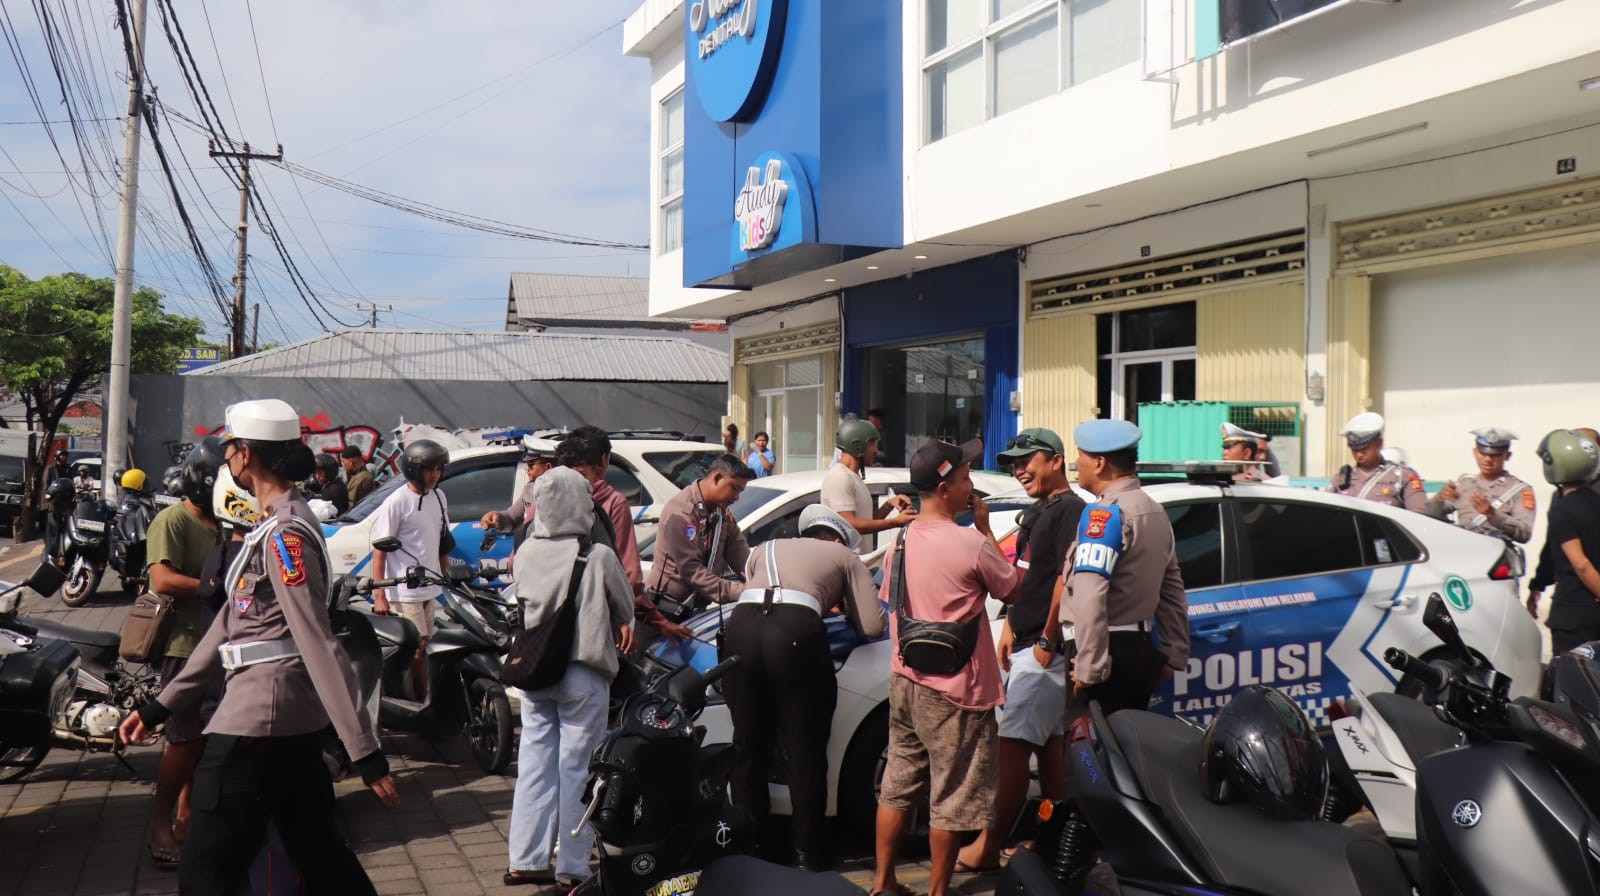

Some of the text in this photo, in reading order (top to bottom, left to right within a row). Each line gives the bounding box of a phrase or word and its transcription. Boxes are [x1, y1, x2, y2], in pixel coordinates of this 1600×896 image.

[196, 349, 217, 359] SAM
[1075, 543, 1119, 574] ROV
[1174, 641, 1322, 696] POLISI
